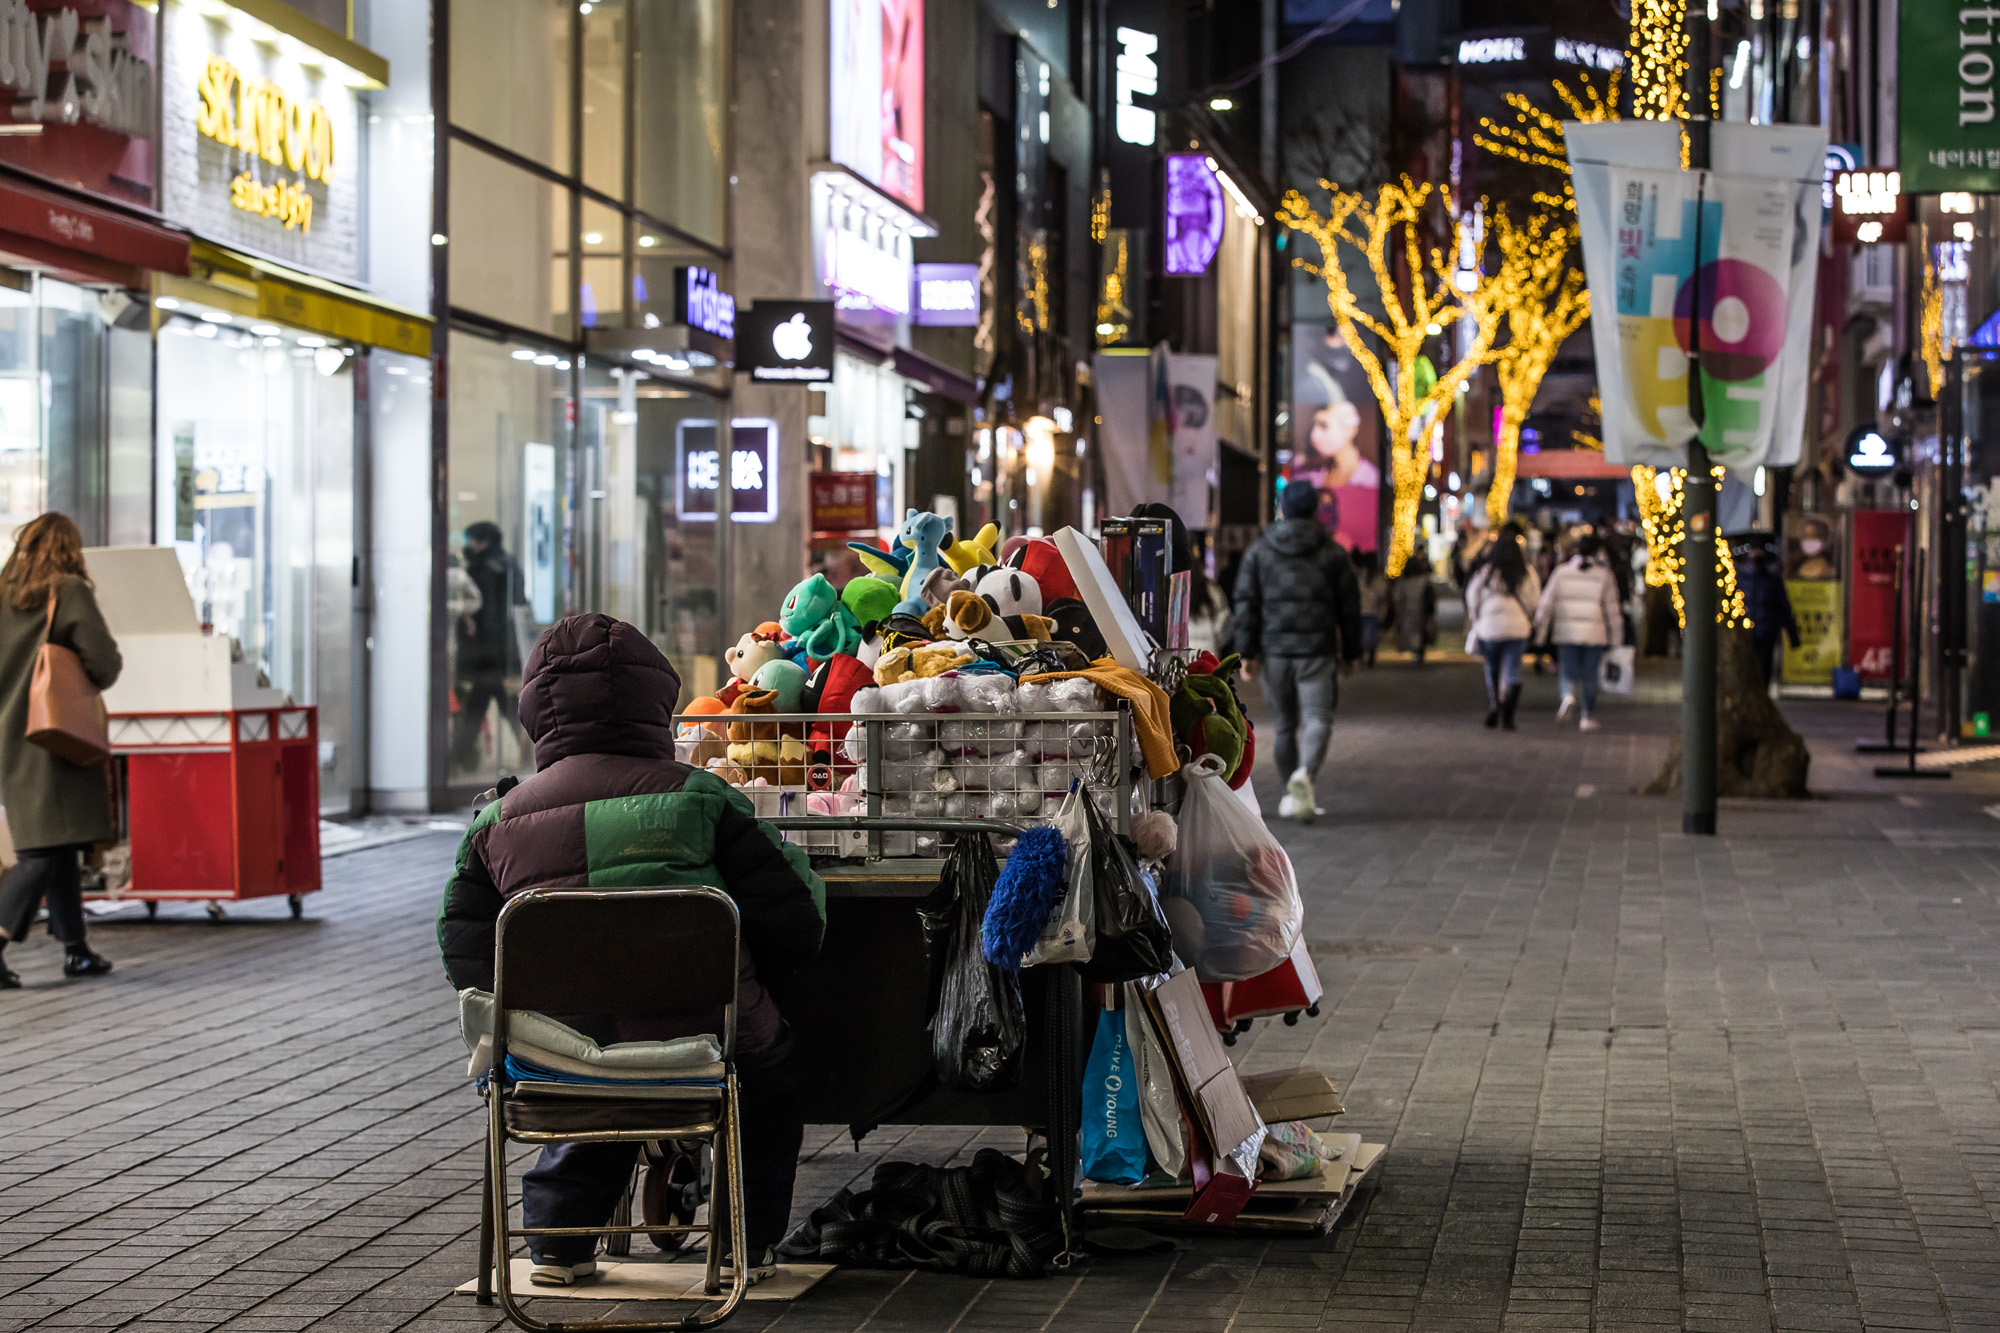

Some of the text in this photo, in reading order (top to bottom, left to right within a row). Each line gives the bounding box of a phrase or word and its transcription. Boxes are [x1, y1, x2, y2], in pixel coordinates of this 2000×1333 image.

[1116, 26, 1159, 147] MLB
[1959, 0, 2000, 127] tion
[1105, 1093, 1118, 1139] YOUNG
